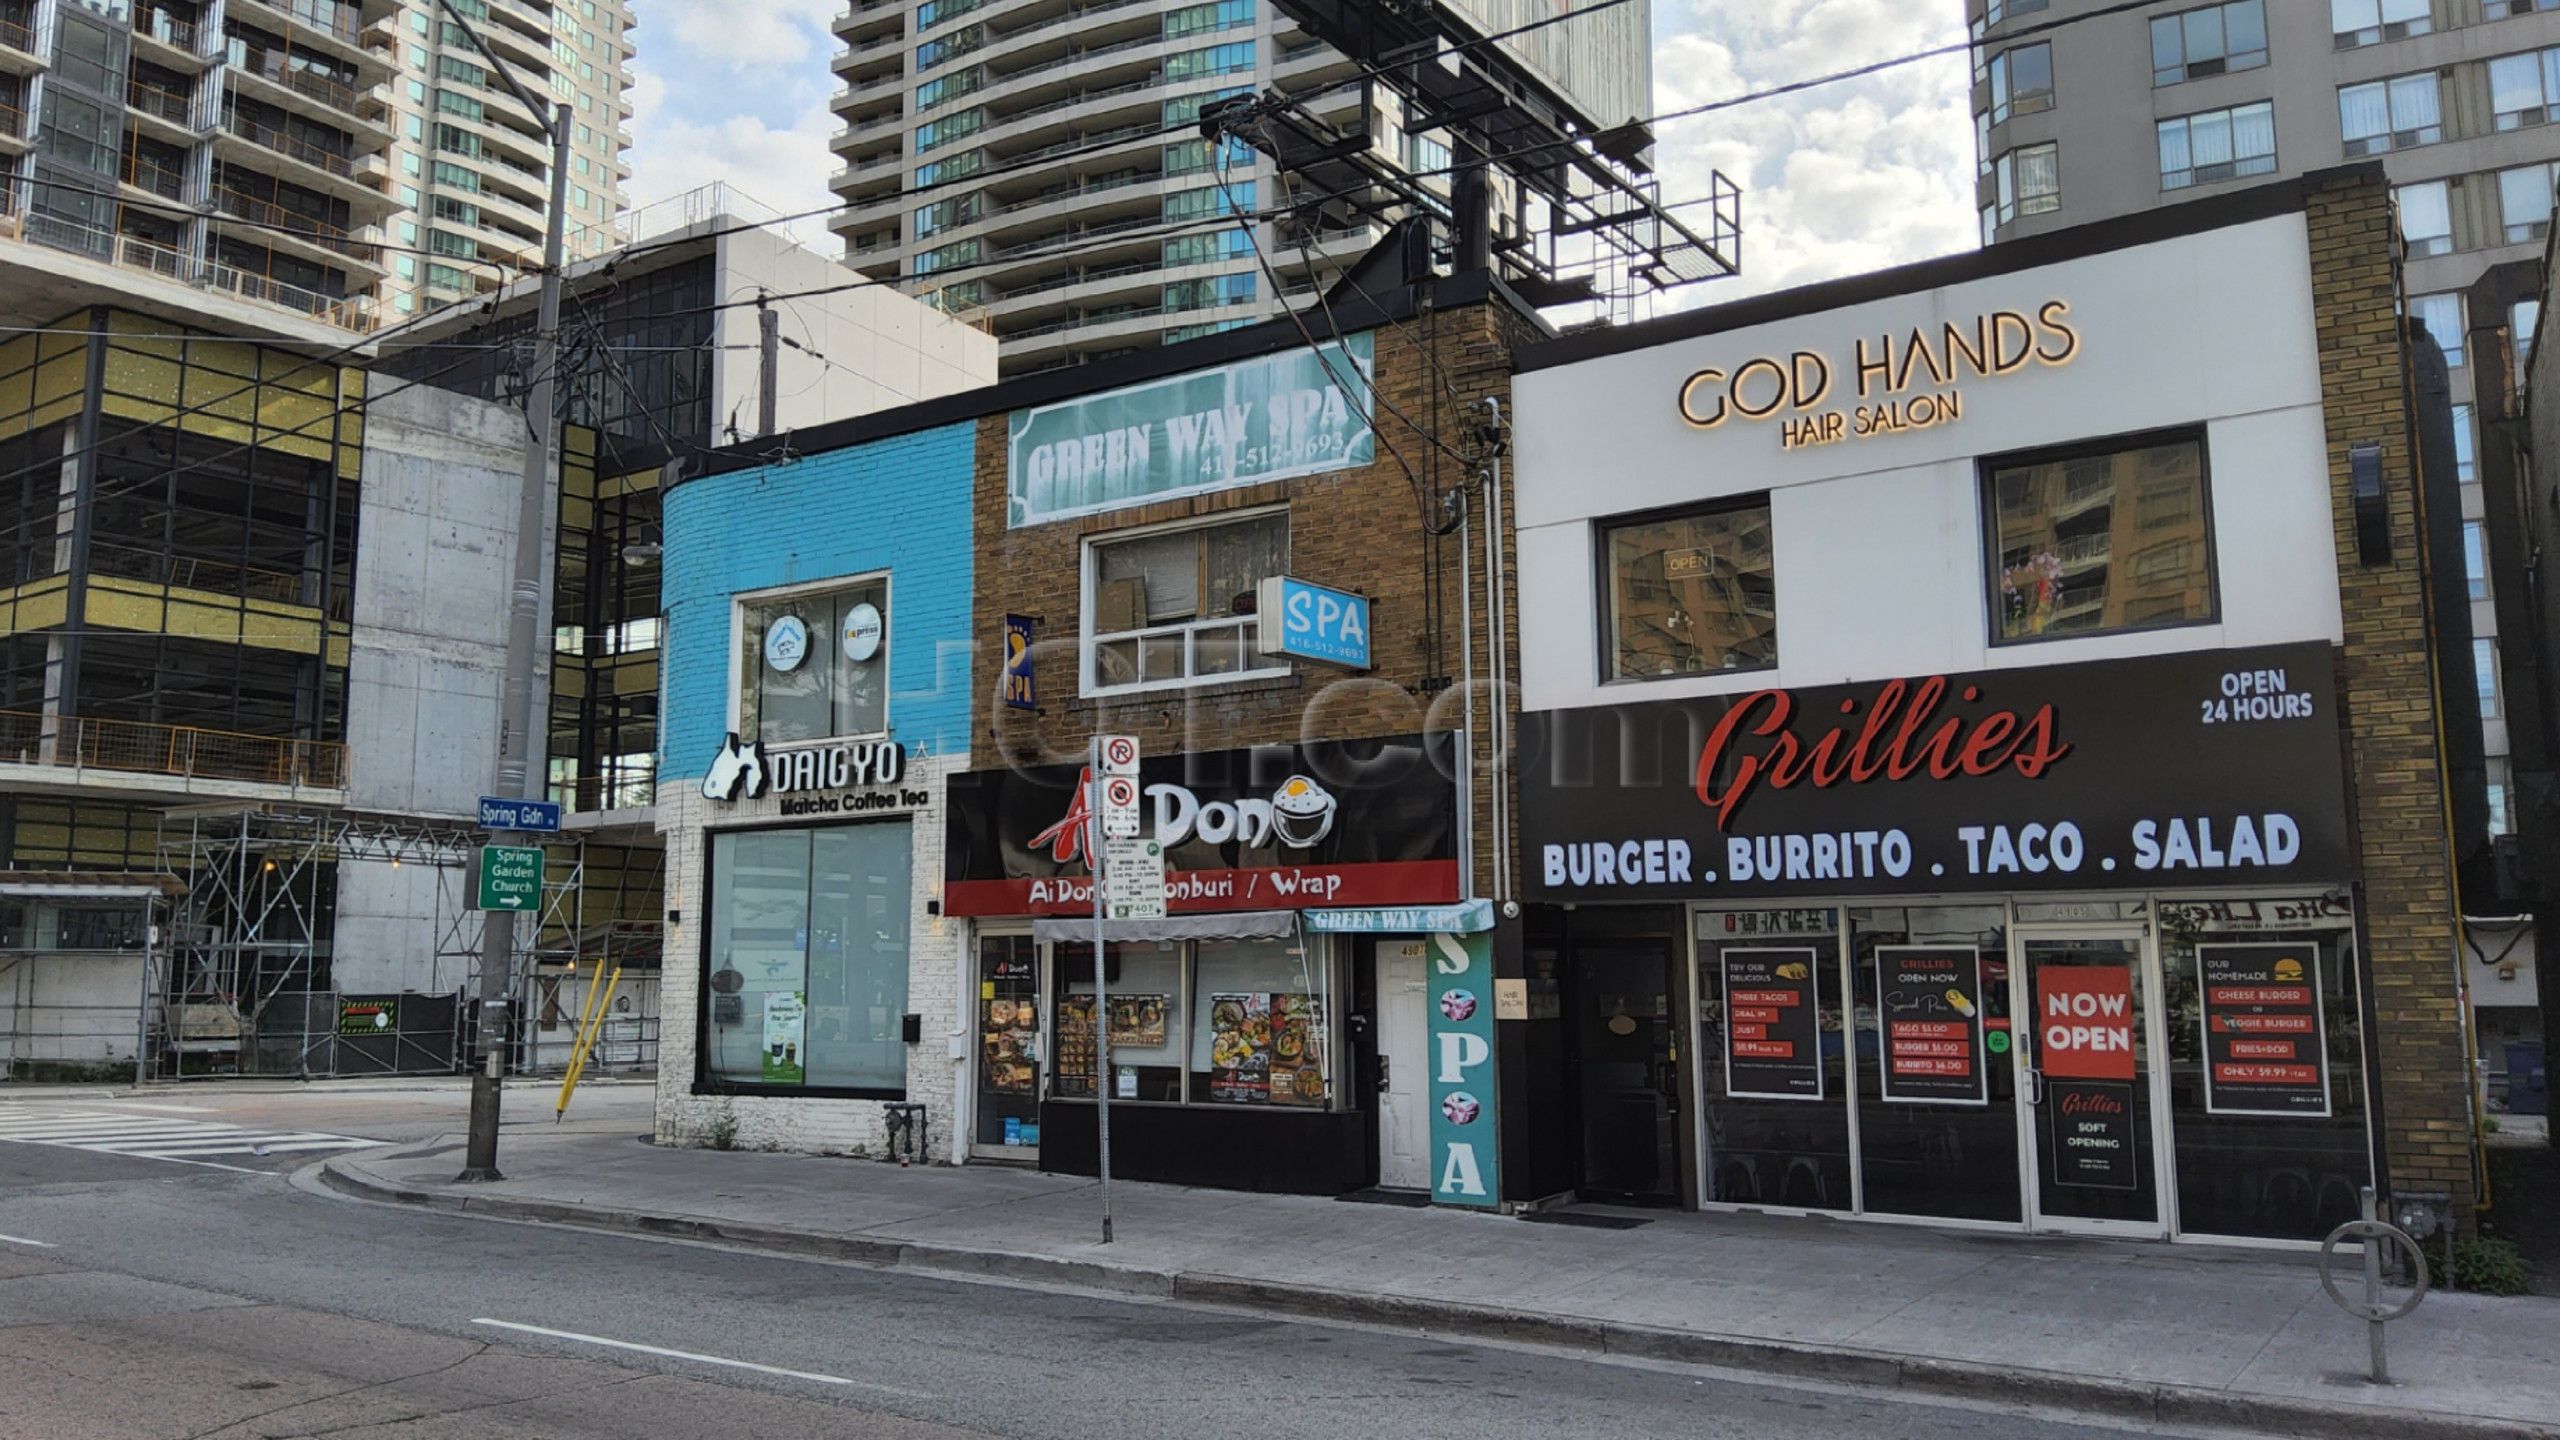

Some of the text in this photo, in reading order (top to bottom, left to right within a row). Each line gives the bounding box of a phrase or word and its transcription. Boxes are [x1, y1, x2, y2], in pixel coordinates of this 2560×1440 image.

[1677, 299, 2077, 427] GOD HANDS
[1780, 389, 1960, 448] HAIR SALON
[1028, 423, 1152, 482] GREEN
[1165, 401, 1253, 458] WAY
[1670, 555, 1708, 570] OPEN
[1287, 590, 1364, 646] SPA
[1006, 674, 1032, 703] SPA
[2221, 669, 2287, 697] OPEN
[2201, 692, 2313, 724] 24 HOURS
[1695, 675, 2070, 833] Grillies
[772, 741, 899, 794] DAIGYO
[780, 788, 928, 815] Matcha Coffee Tea
[481, 803, 516, 827] Spring
[520, 805, 543, 825] Gdn
[496, 850, 533, 865] Spring
[1543, 839, 1693, 887] BURGER
[1730, 829, 1911, 882] BURRITO
[1958, 820, 2083, 873] TACO
[2133, 813, 2301, 871] SALAD
[492, 865, 534, 878] Garden
[491, 879, 533, 893] Church
[1164, 873, 1233, 900] onburi
[1270, 868, 1342, 900] Wrap
[1313, 911, 1463, 930] GREEN WAY SPA
[1730, 964, 1765, 972] TRY OUR
[2207, 960, 2230, 968] OUR
[1730, 974, 1772, 982] DELICIOUS
[1898, 973, 1959, 983] OPEN NOW
[2208, 971, 2268, 981] HOMEMADE
[1762, 994, 1788, 1002] TACOS
[2217, 990, 2301, 1000] CHEESE BURGER
[2047, 992, 2127, 1018] NOW
[1736, 1026, 1755, 1034] JUST
[2224, 1018, 2306, 1028] VEGGIE BURGER
[2046, 1025, 2130, 1051] OPEN
[1894, 1043, 1930, 1051] BURGER
[1896, 1060, 1933, 1069] BURRITO
[2223, 1067, 2255, 1076] ONLY
[2062, 1093, 2124, 1117] Grillies
[2078, 1122, 2107, 1133] SOFT
[2067, 1136, 2120, 1149] OPENING
